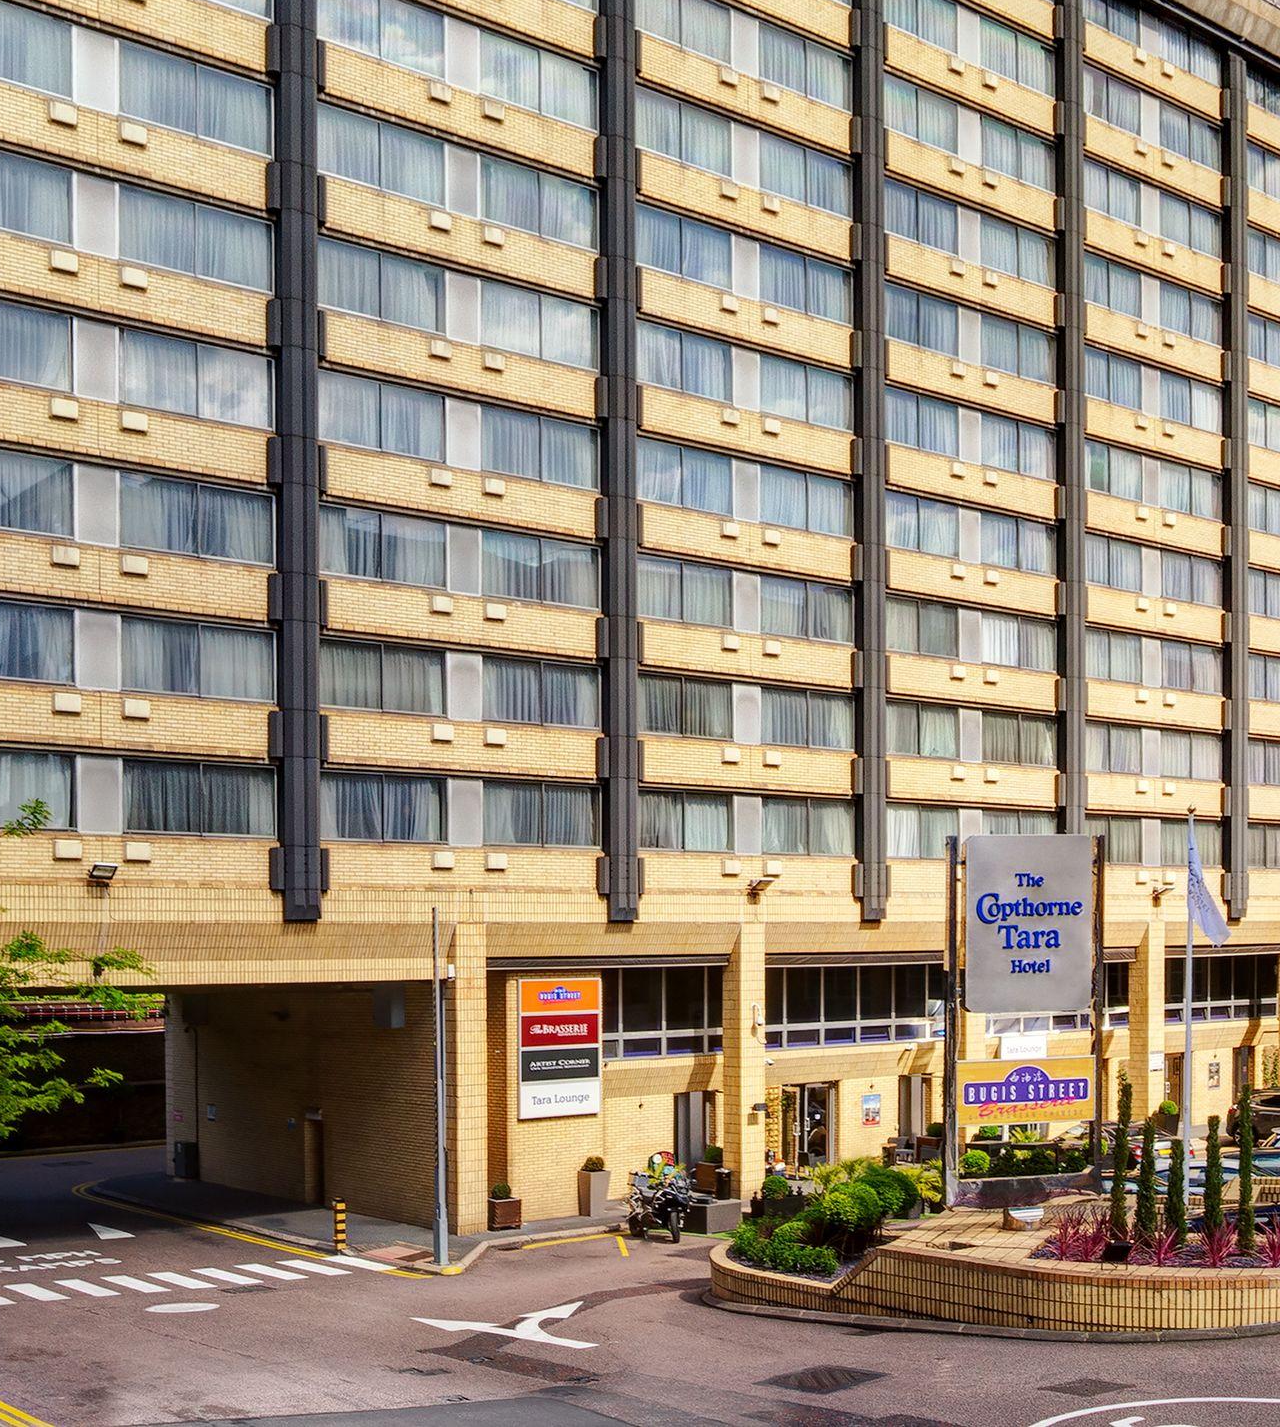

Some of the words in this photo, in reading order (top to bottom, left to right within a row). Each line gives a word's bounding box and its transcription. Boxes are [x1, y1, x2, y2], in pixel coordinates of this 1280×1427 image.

[1014, 872, 1044, 887] The
[976, 892, 1084, 924] Copthorne
[997, 924, 1061, 949] Tara
[1010, 959, 1051, 974] Hotel
[543, 1023, 588, 1035] BRASSERIE
[968, 1085, 1017, 1102] BUGIS
[1028, 1082, 1085, 1100] STREET
[532, 1096, 552, 1106] Tara
[554, 1094, 590, 1104] Lounge
[978, 1095, 1077, 1118] Brasserie
[15, 1249, 102, 1262] MPH
